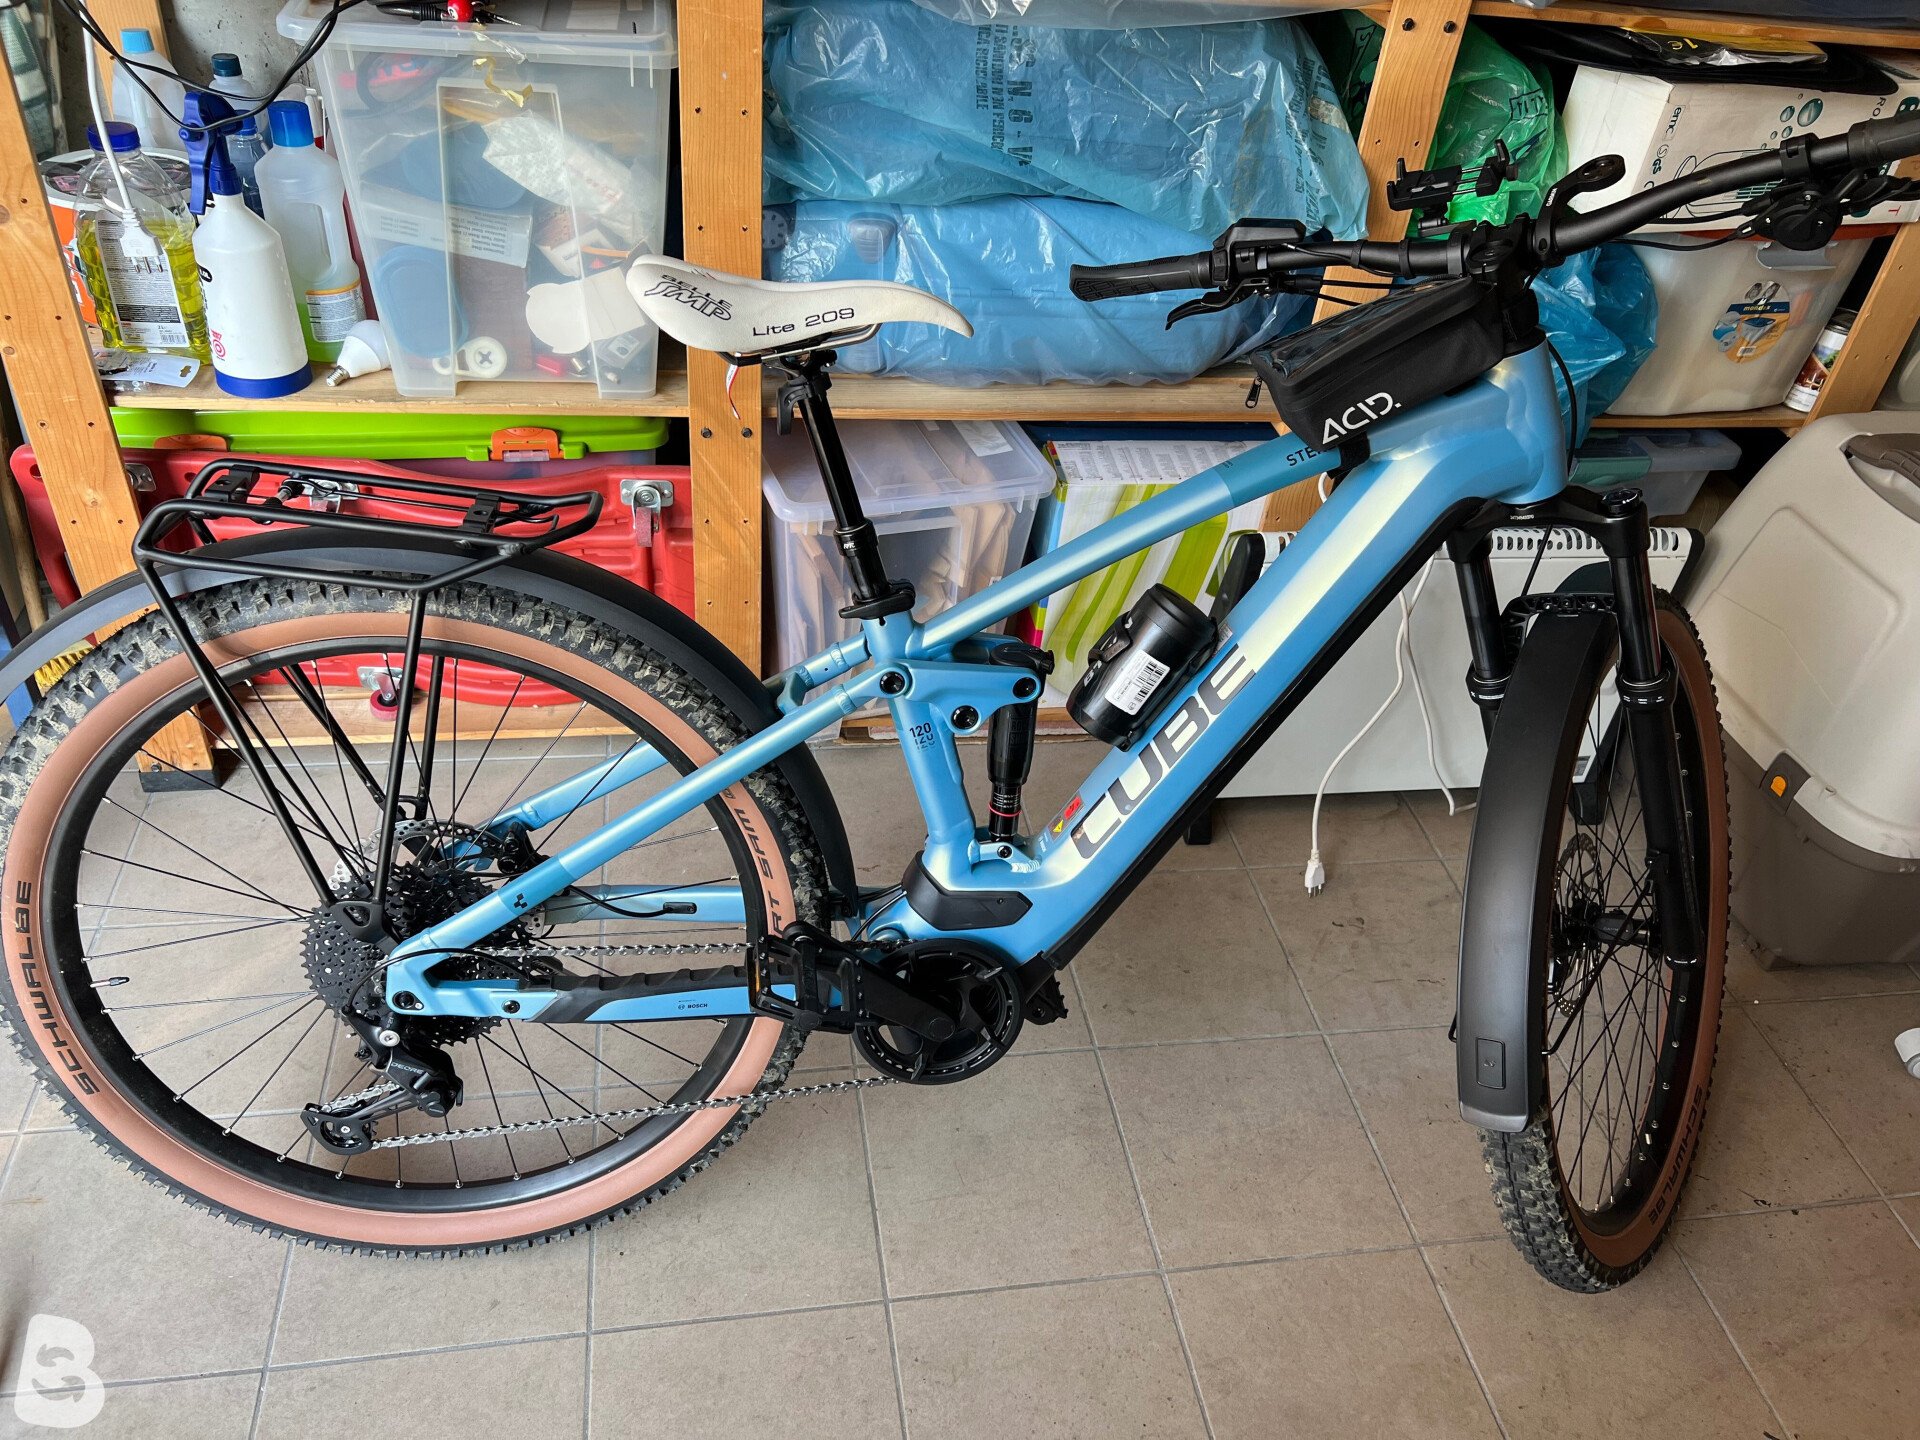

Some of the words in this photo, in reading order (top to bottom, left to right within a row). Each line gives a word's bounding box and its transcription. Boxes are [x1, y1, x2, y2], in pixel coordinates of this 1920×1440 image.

[991, 87, 1005, 110] NON
[1008, 109, 1033, 123] 6
[1665, 107, 1682, 136] emc
[661, 274, 733, 311] SELLE
[752, 323, 795, 337] Lite
[805, 307, 856, 328] 209
[1286, 446, 1327, 467] STE
[909, 722, 932, 738] 120
[1070, 643, 1257, 859] CUBE
[734, 808, 774, 880] SAM
[15, 880, 100, 1095] SCHWALBE
[390, 1062, 425, 1075] DEORE
[1648, 1085, 1703, 1225] SCHWALBE
